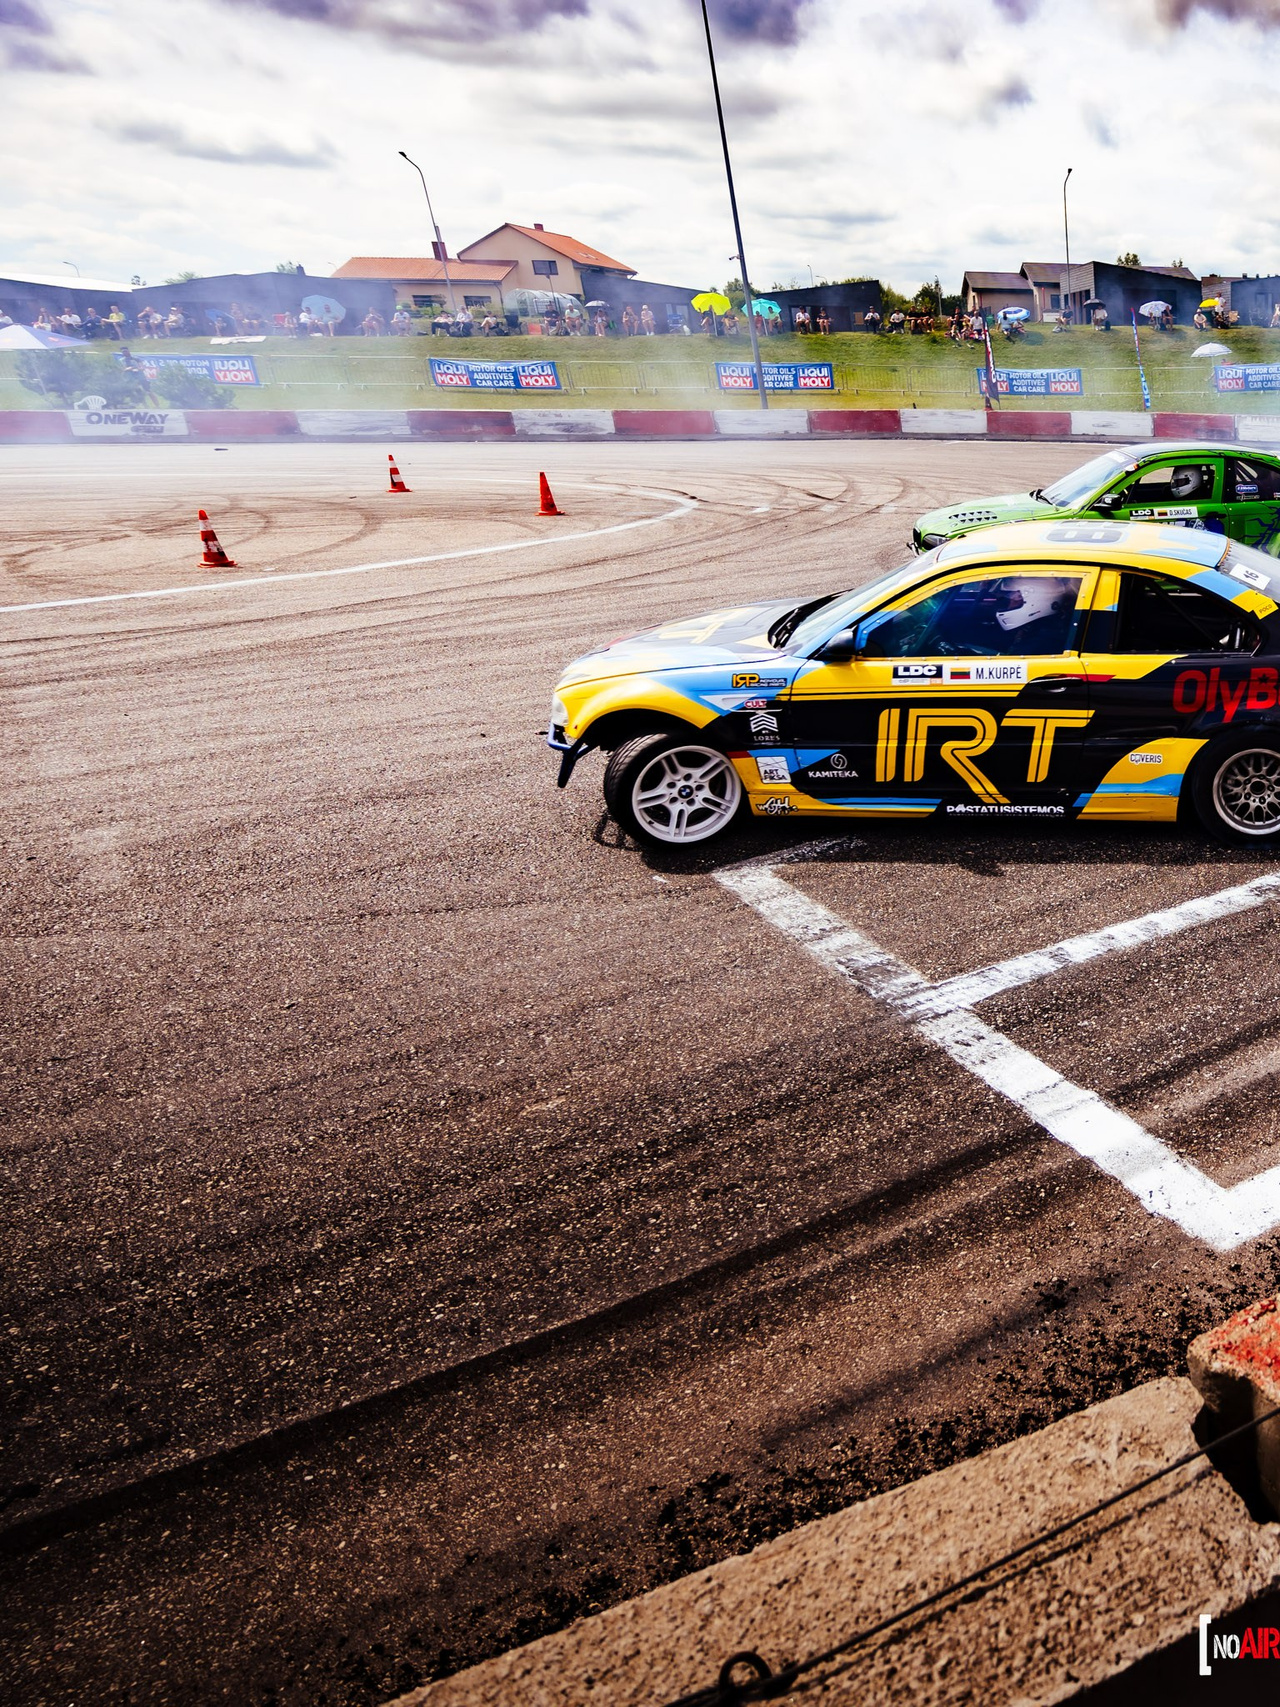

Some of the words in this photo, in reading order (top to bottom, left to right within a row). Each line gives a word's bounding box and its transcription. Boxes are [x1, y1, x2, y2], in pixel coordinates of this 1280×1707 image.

[435, 363, 466, 374] LIQUI
[519, 365, 552, 375] LIQUI
[721, 366, 750, 377] LIQUI
[779, 367, 796, 375] OILS
[799, 367, 828, 376] LIQUI
[1051, 372, 1077, 382] LIQUI
[1219, 369, 1243, 379] LIQUI
[437, 374, 469, 385] MOLY
[476, 379, 495, 387] CAR
[521, 376, 555, 386] MOLY
[722, 377, 752, 387] MOLY
[800, 378, 830, 387] MOLY
[1219, 379, 1244, 389] MOLY
[1051, 382, 1079, 392] MOLY
[745, 699, 767, 708] CULT
[875, 708, 1096, 804] IRT
[808, 770, 859, 778] KAMITEKA
